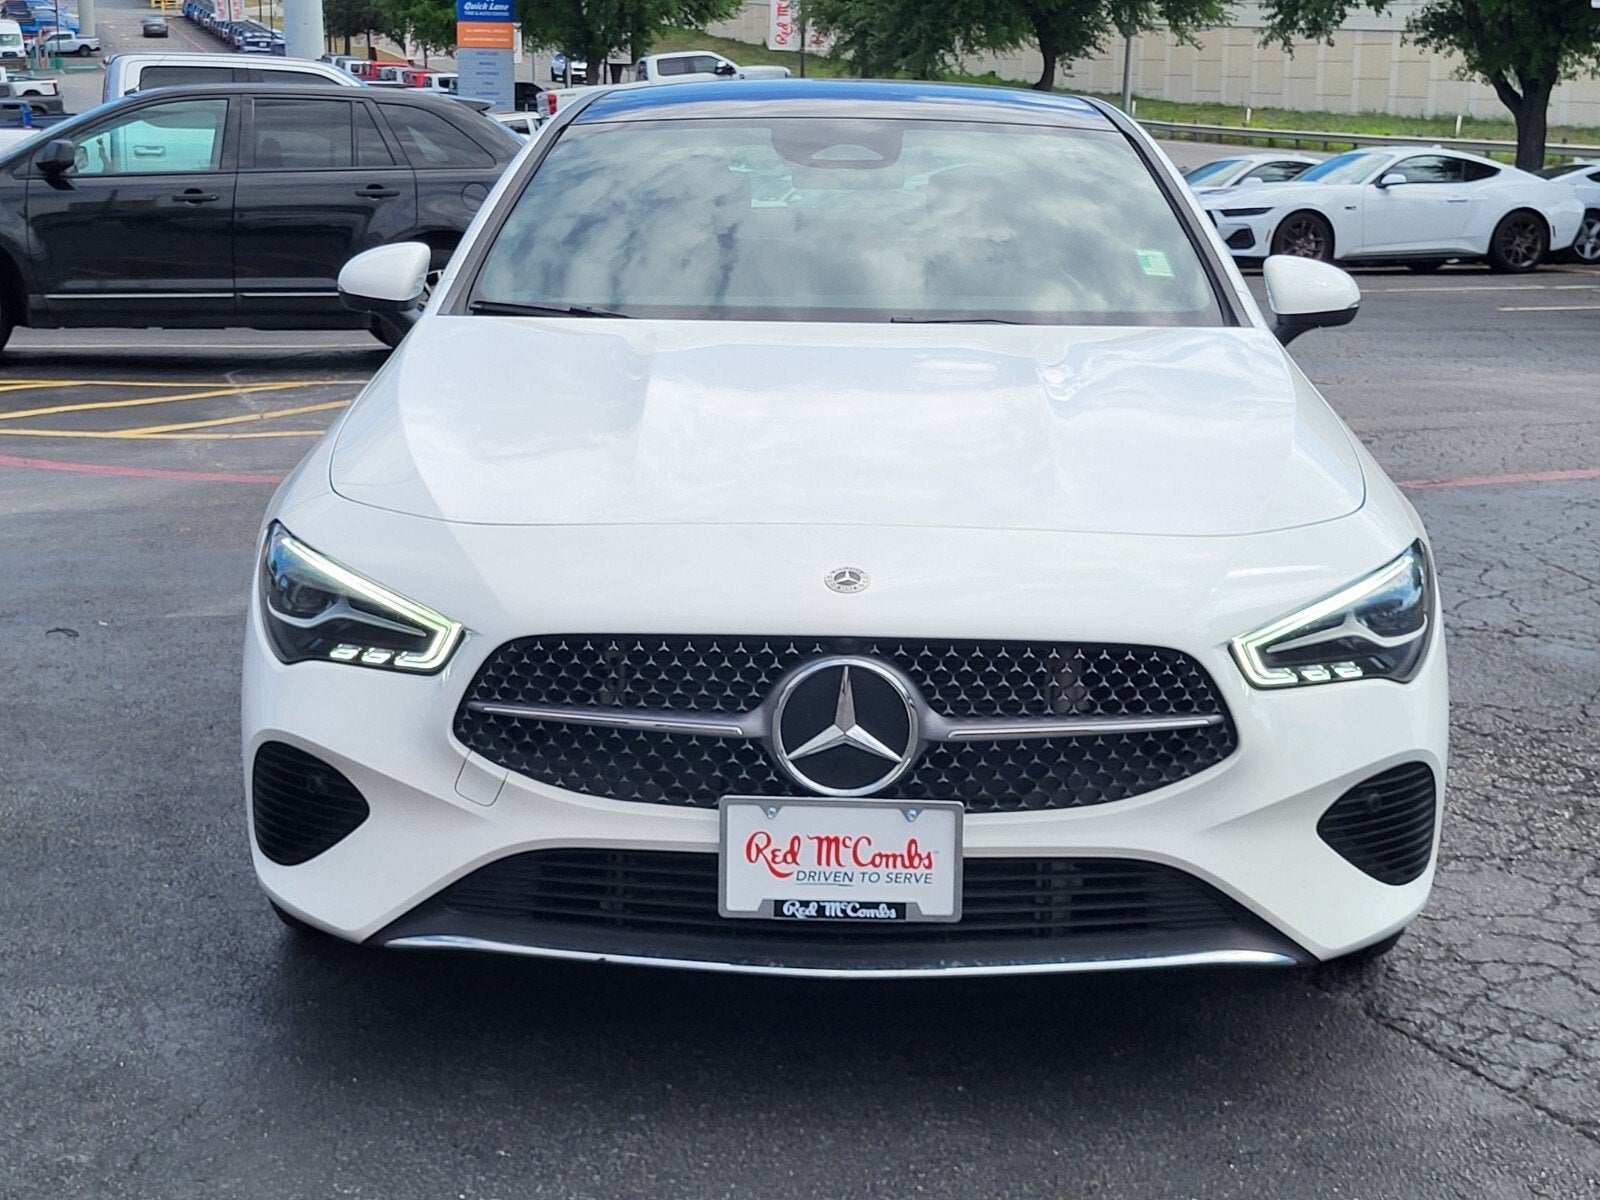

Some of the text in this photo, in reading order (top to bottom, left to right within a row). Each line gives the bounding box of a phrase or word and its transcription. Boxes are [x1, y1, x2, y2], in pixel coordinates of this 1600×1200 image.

[464, 2, 509, 11] Quick Lane
[775, 22, 794, 44] Red
[746, 831, 933, 878] Red McCombs
[796, 870, 933, 884] DRIVEN TO SERVE
[782, 900, 897, 919] Red McCombs
